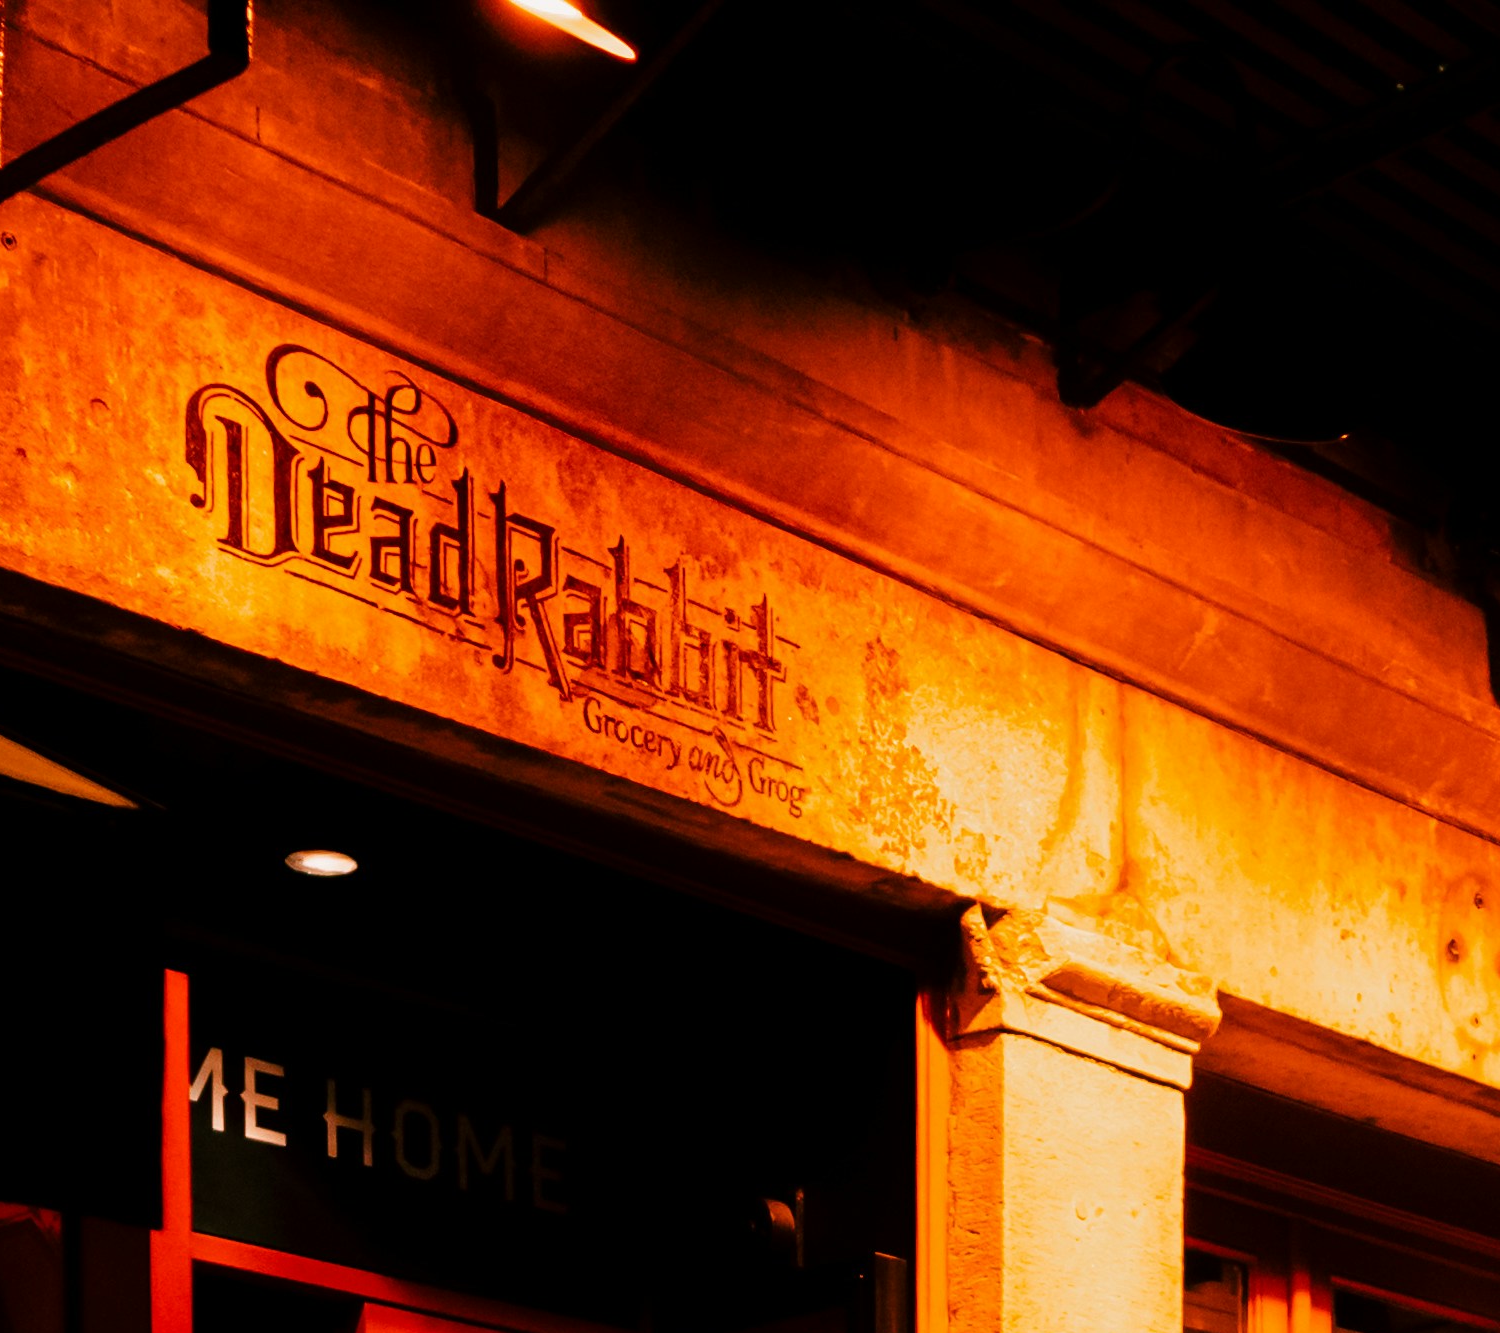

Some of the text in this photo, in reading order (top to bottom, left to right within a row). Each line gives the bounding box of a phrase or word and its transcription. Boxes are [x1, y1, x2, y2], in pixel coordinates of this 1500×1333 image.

[266, 343, 457, 485] The
[185, 384, 786, 735] Dead Rabbit
[583, 698, 805, 818] Grocery and Grog
[323, 1076, 574, 1217] HOME
